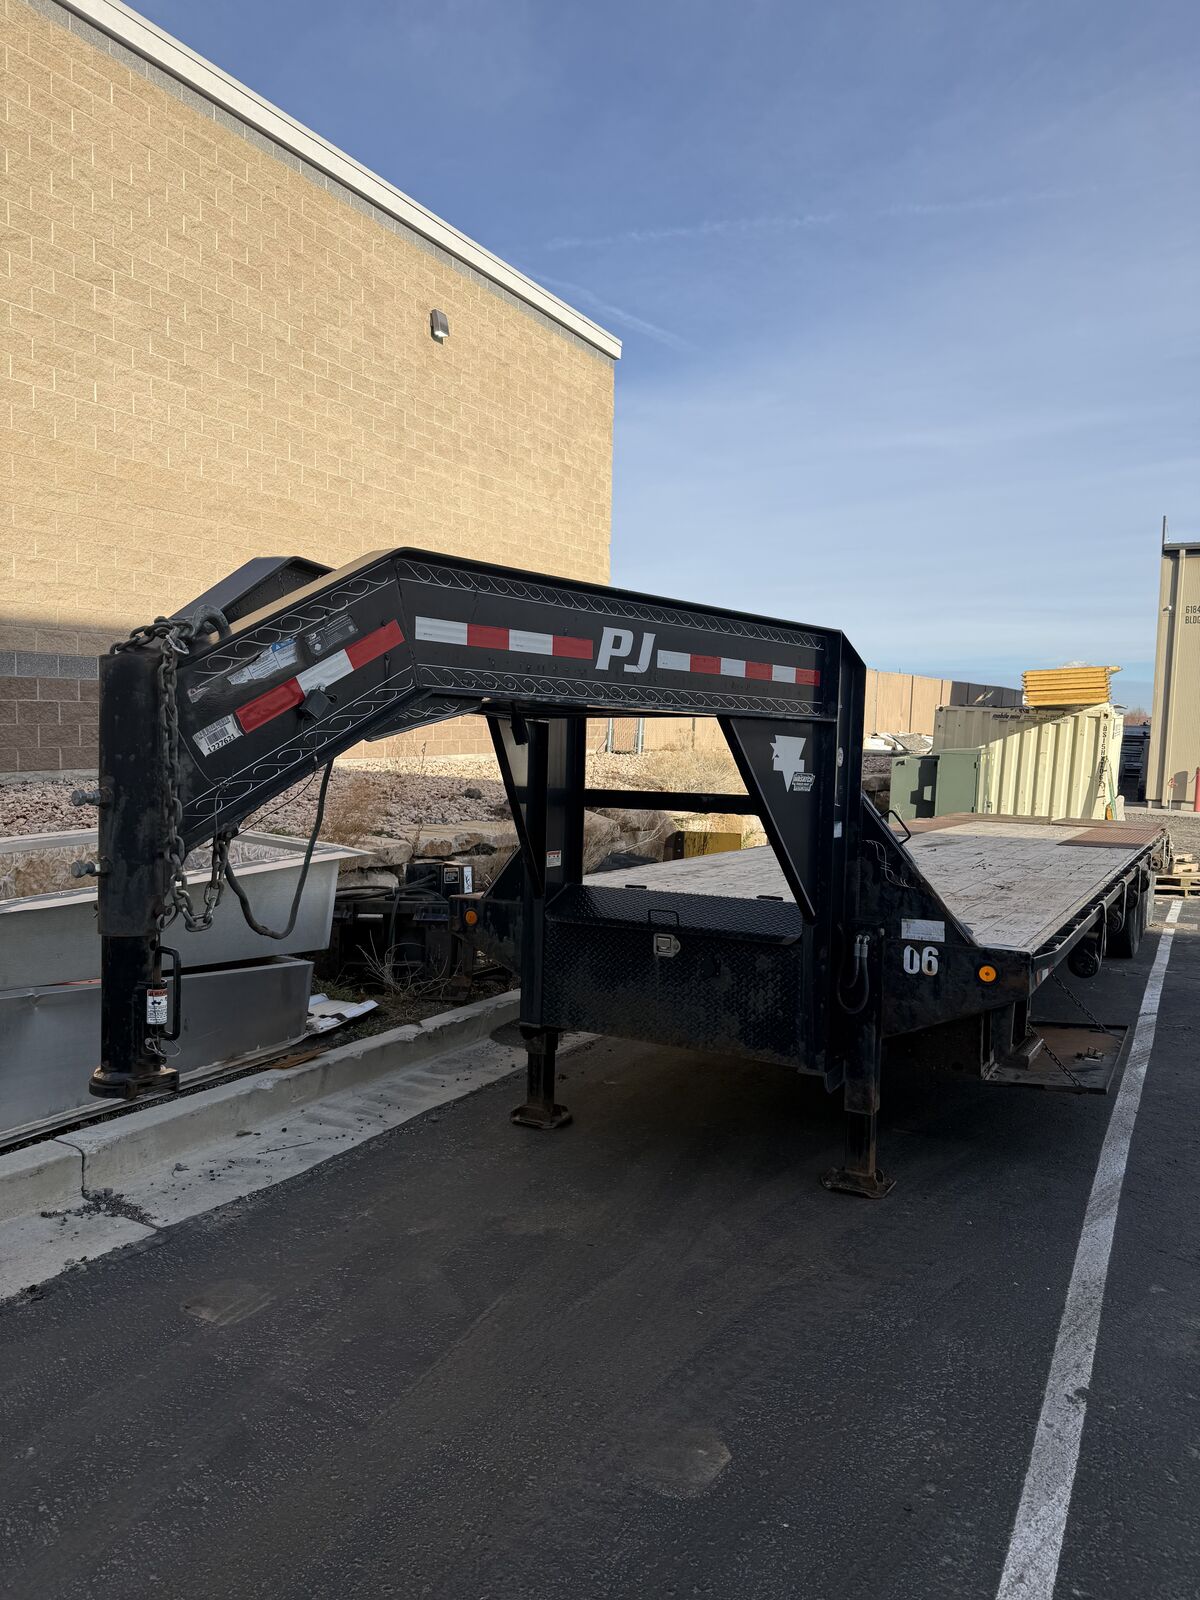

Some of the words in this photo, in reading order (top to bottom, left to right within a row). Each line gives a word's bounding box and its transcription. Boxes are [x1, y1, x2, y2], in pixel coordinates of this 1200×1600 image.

[595, 626, 656, 673] PJ
[207, 733, 236, 752] 1227621
[903, 945, 939, 976] 06
